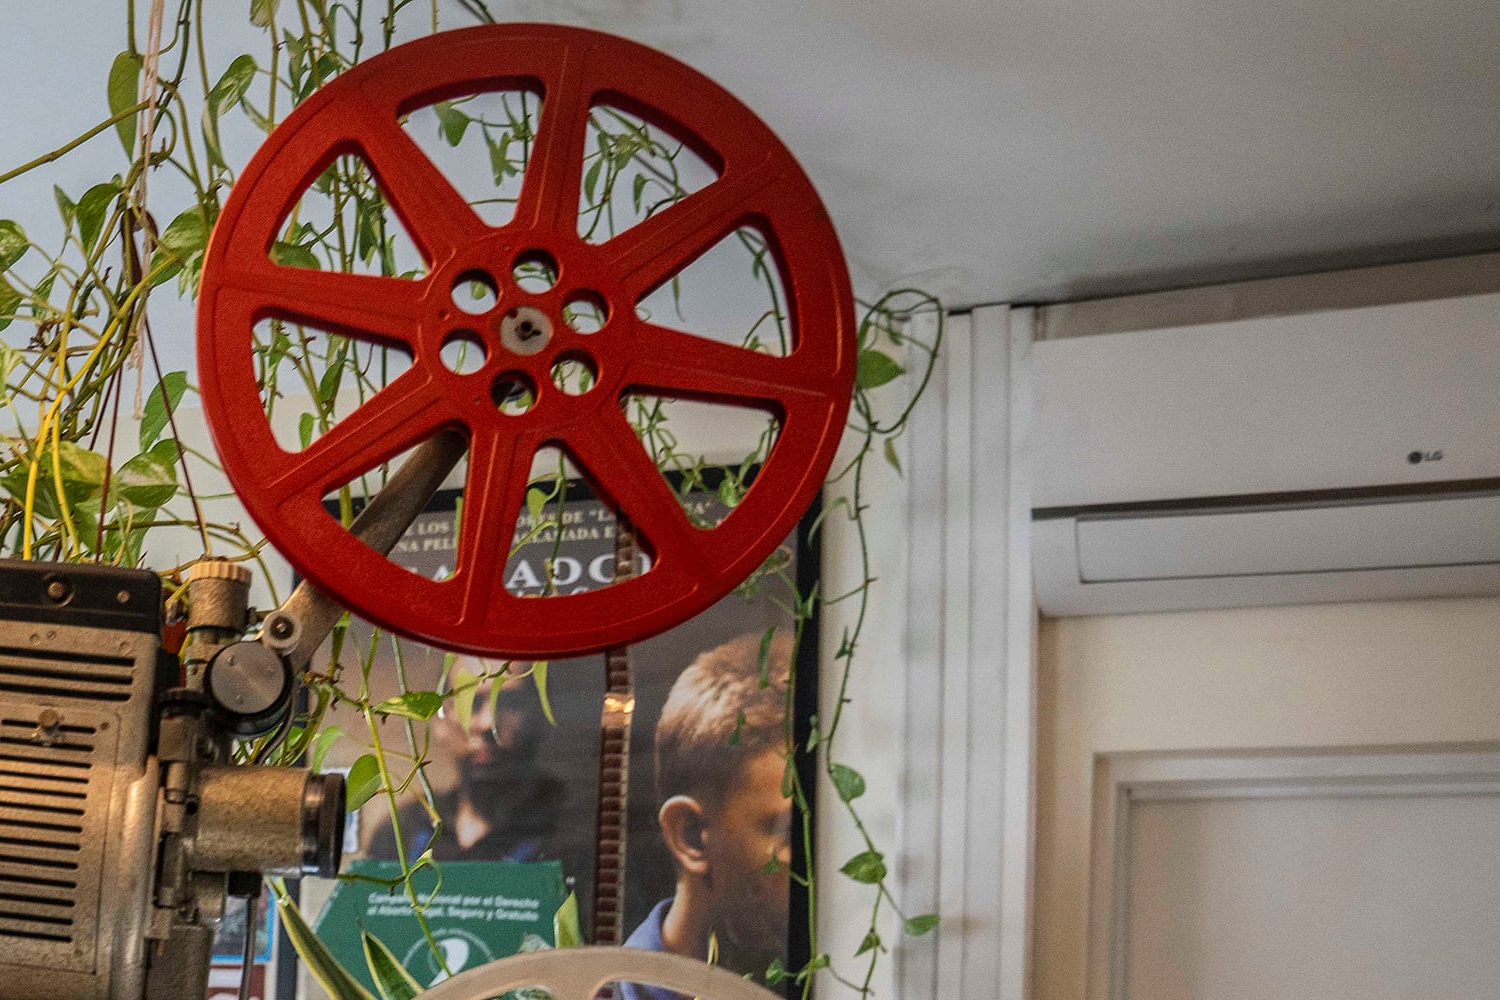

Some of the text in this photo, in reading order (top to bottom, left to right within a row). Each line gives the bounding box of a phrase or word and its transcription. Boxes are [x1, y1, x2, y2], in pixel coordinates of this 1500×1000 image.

[463, 896, 482, 906] por
[483, 895, 493, 905] el
[494, 896, 540, 910] Derecho
[448, 906, 485, 919] Seguro
[486, 910, 493, 921] y
[494, 908, 539, 921] Gratuito
